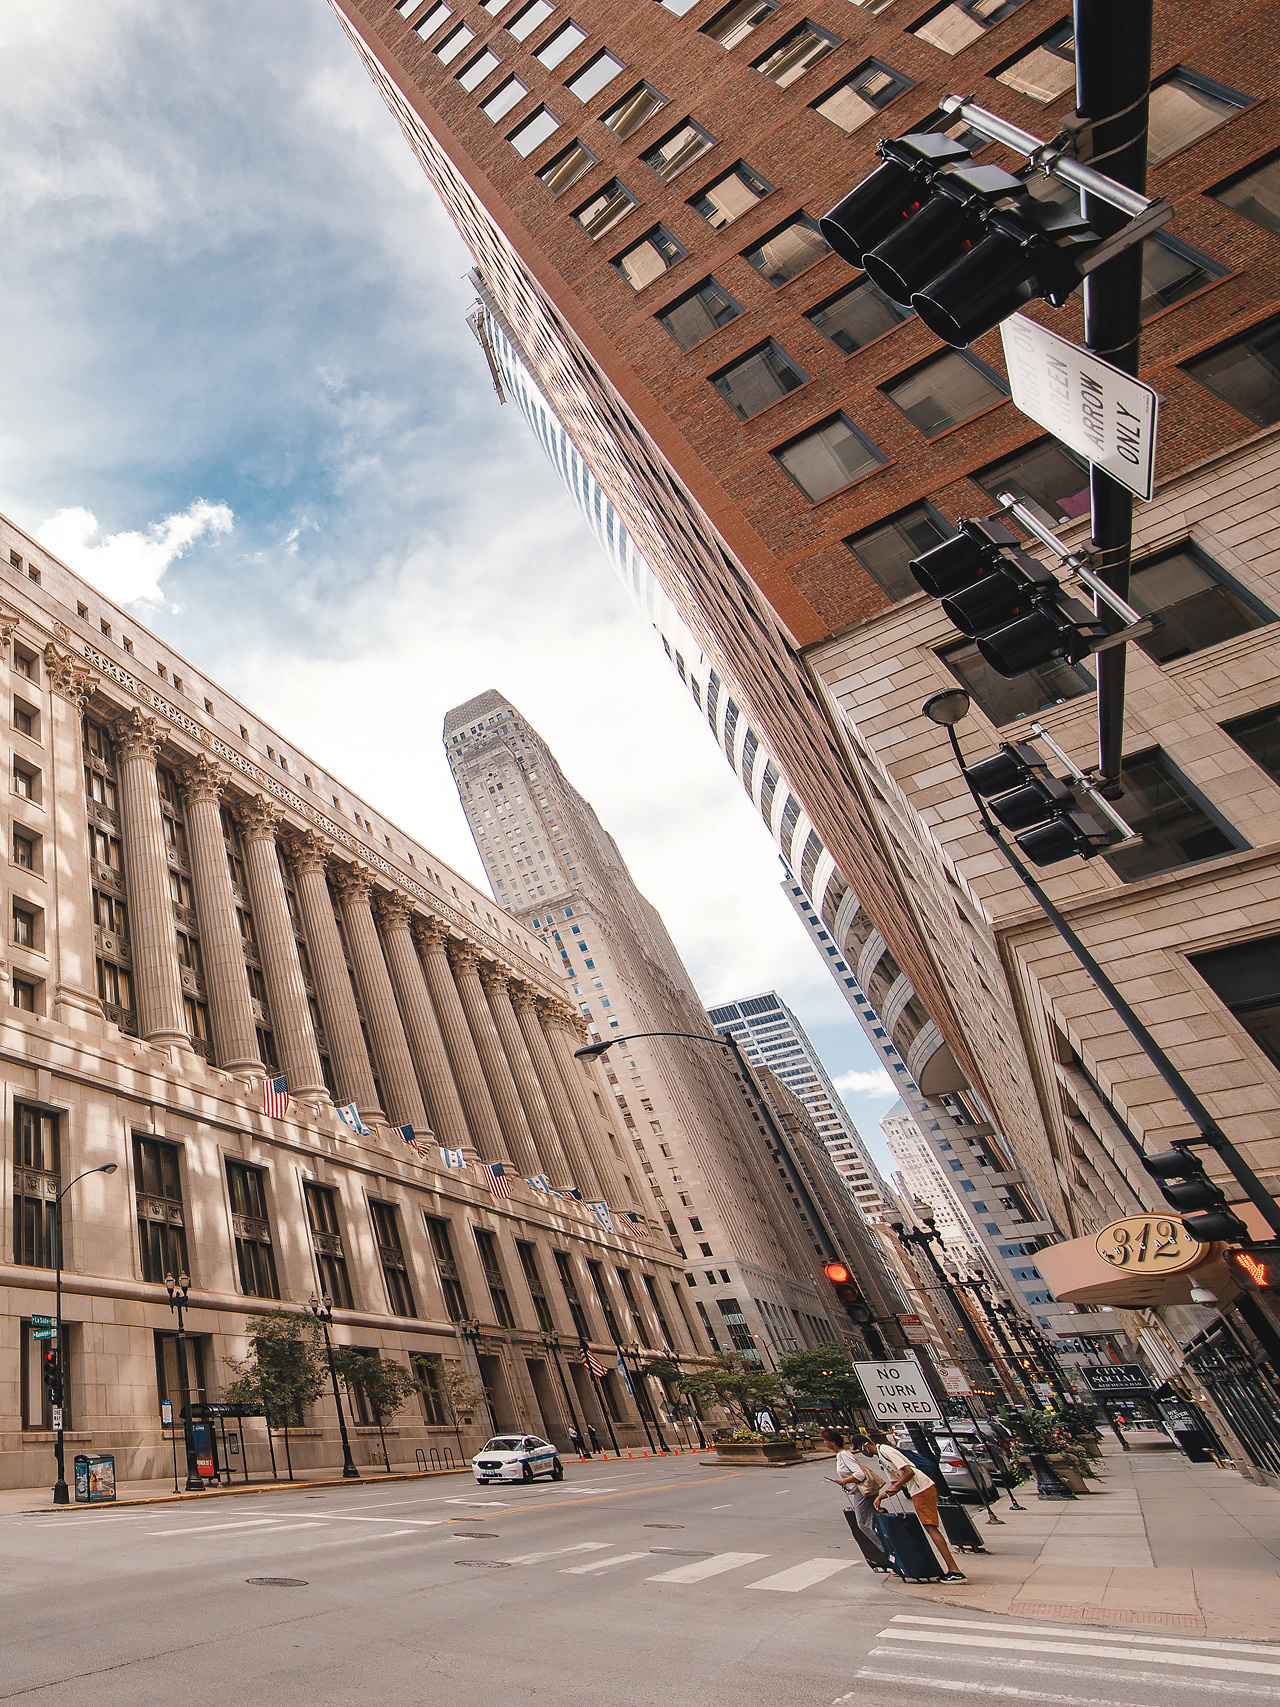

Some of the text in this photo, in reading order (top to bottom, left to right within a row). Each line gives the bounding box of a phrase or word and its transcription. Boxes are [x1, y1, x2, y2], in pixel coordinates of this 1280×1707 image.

[1011, 319, 1042, 417] RIGHT ON
[1045, 353, 1072, 424] GREEN
[1080, 371, 1104, 452] ARROW
[1116, 402, 1141, 465] ONLY
[1100, 1233, 1192, 1257] CHICAGO
[1106, 1221, 1180, 1265] 312
[876, 1368, 900, 1380] NO
[1092, 1374, 1142, 1383] SOCIAL
[1095, 1366, 1126, 1375] CITY
[876, 1385, 917, 1396] TURN
[877, 1402, 932, 1414] ON RED
[1170, 1411, 1189, 1420] CATER
